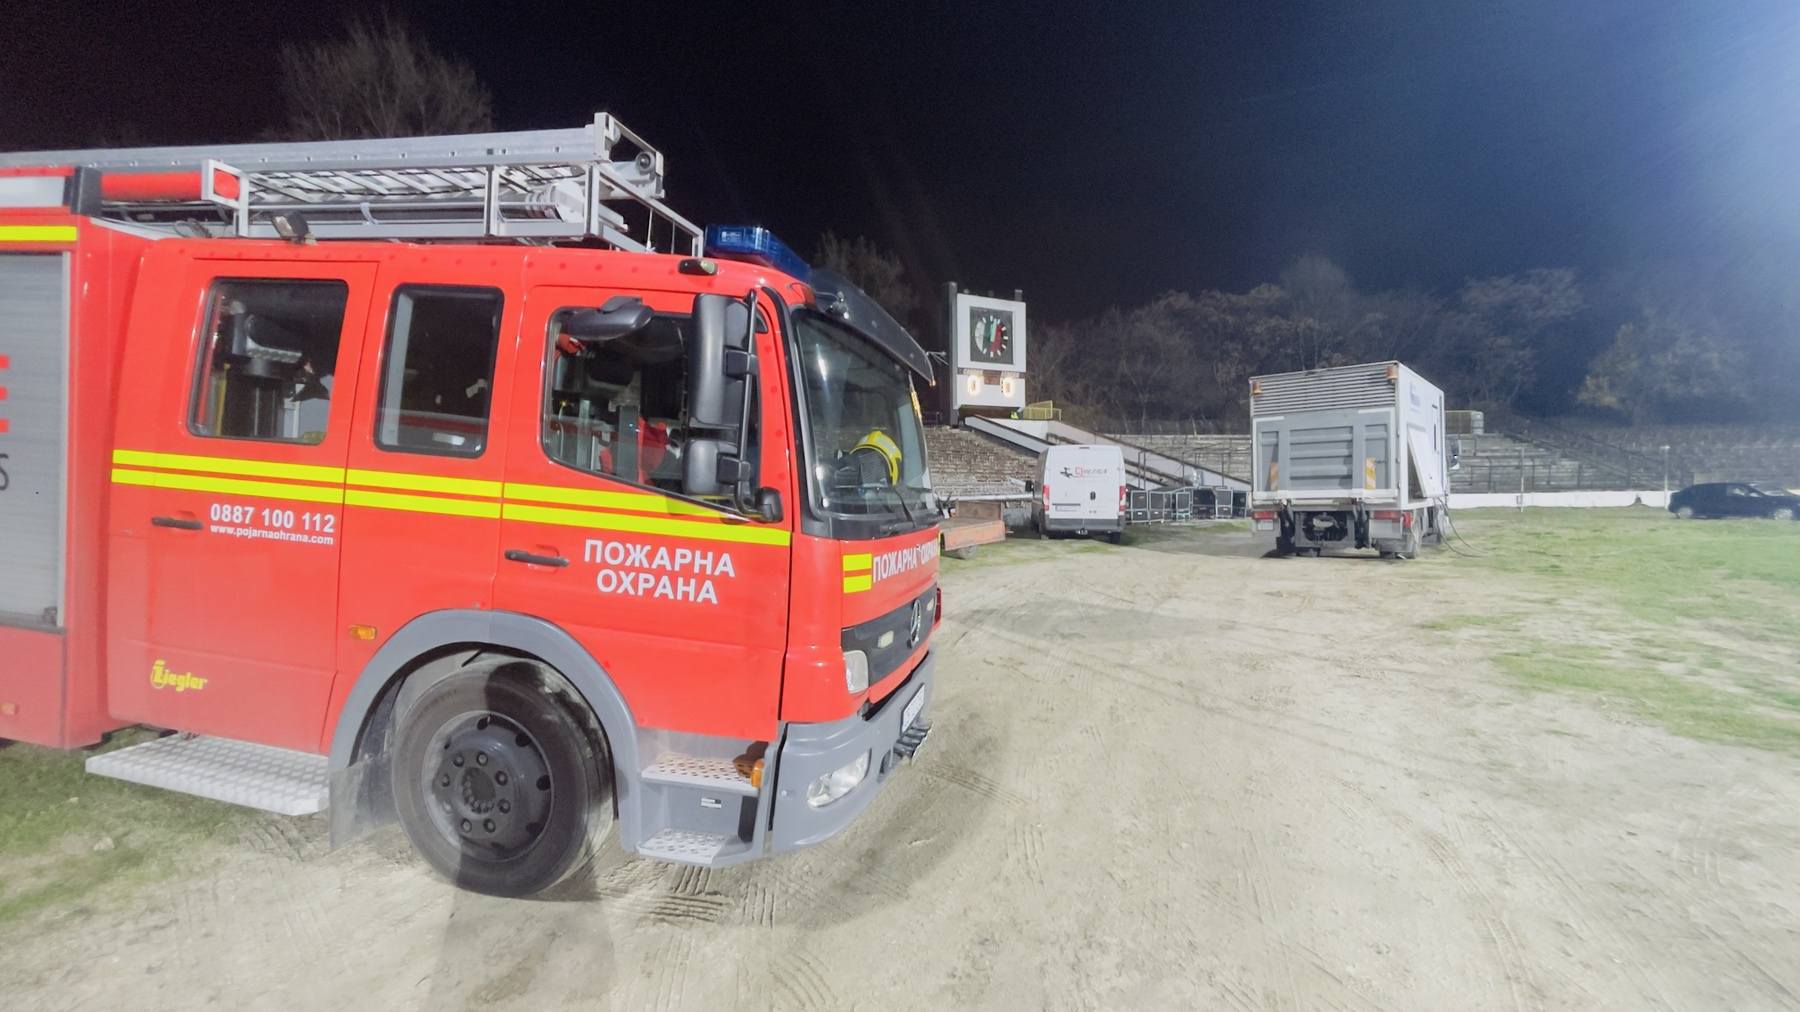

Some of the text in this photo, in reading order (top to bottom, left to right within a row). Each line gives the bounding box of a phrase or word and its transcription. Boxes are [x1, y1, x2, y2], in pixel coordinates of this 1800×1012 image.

[210, 503, 335, 533] 0887 100 112
[210, 524, 334, 545] www.pojarnaohrana.com
[584, 538, 736, 578] ПОЖАРНА
[872, 547, 917, 583] ПОЖАРНА
[596, 568, 718, 605] ОХРАНА
